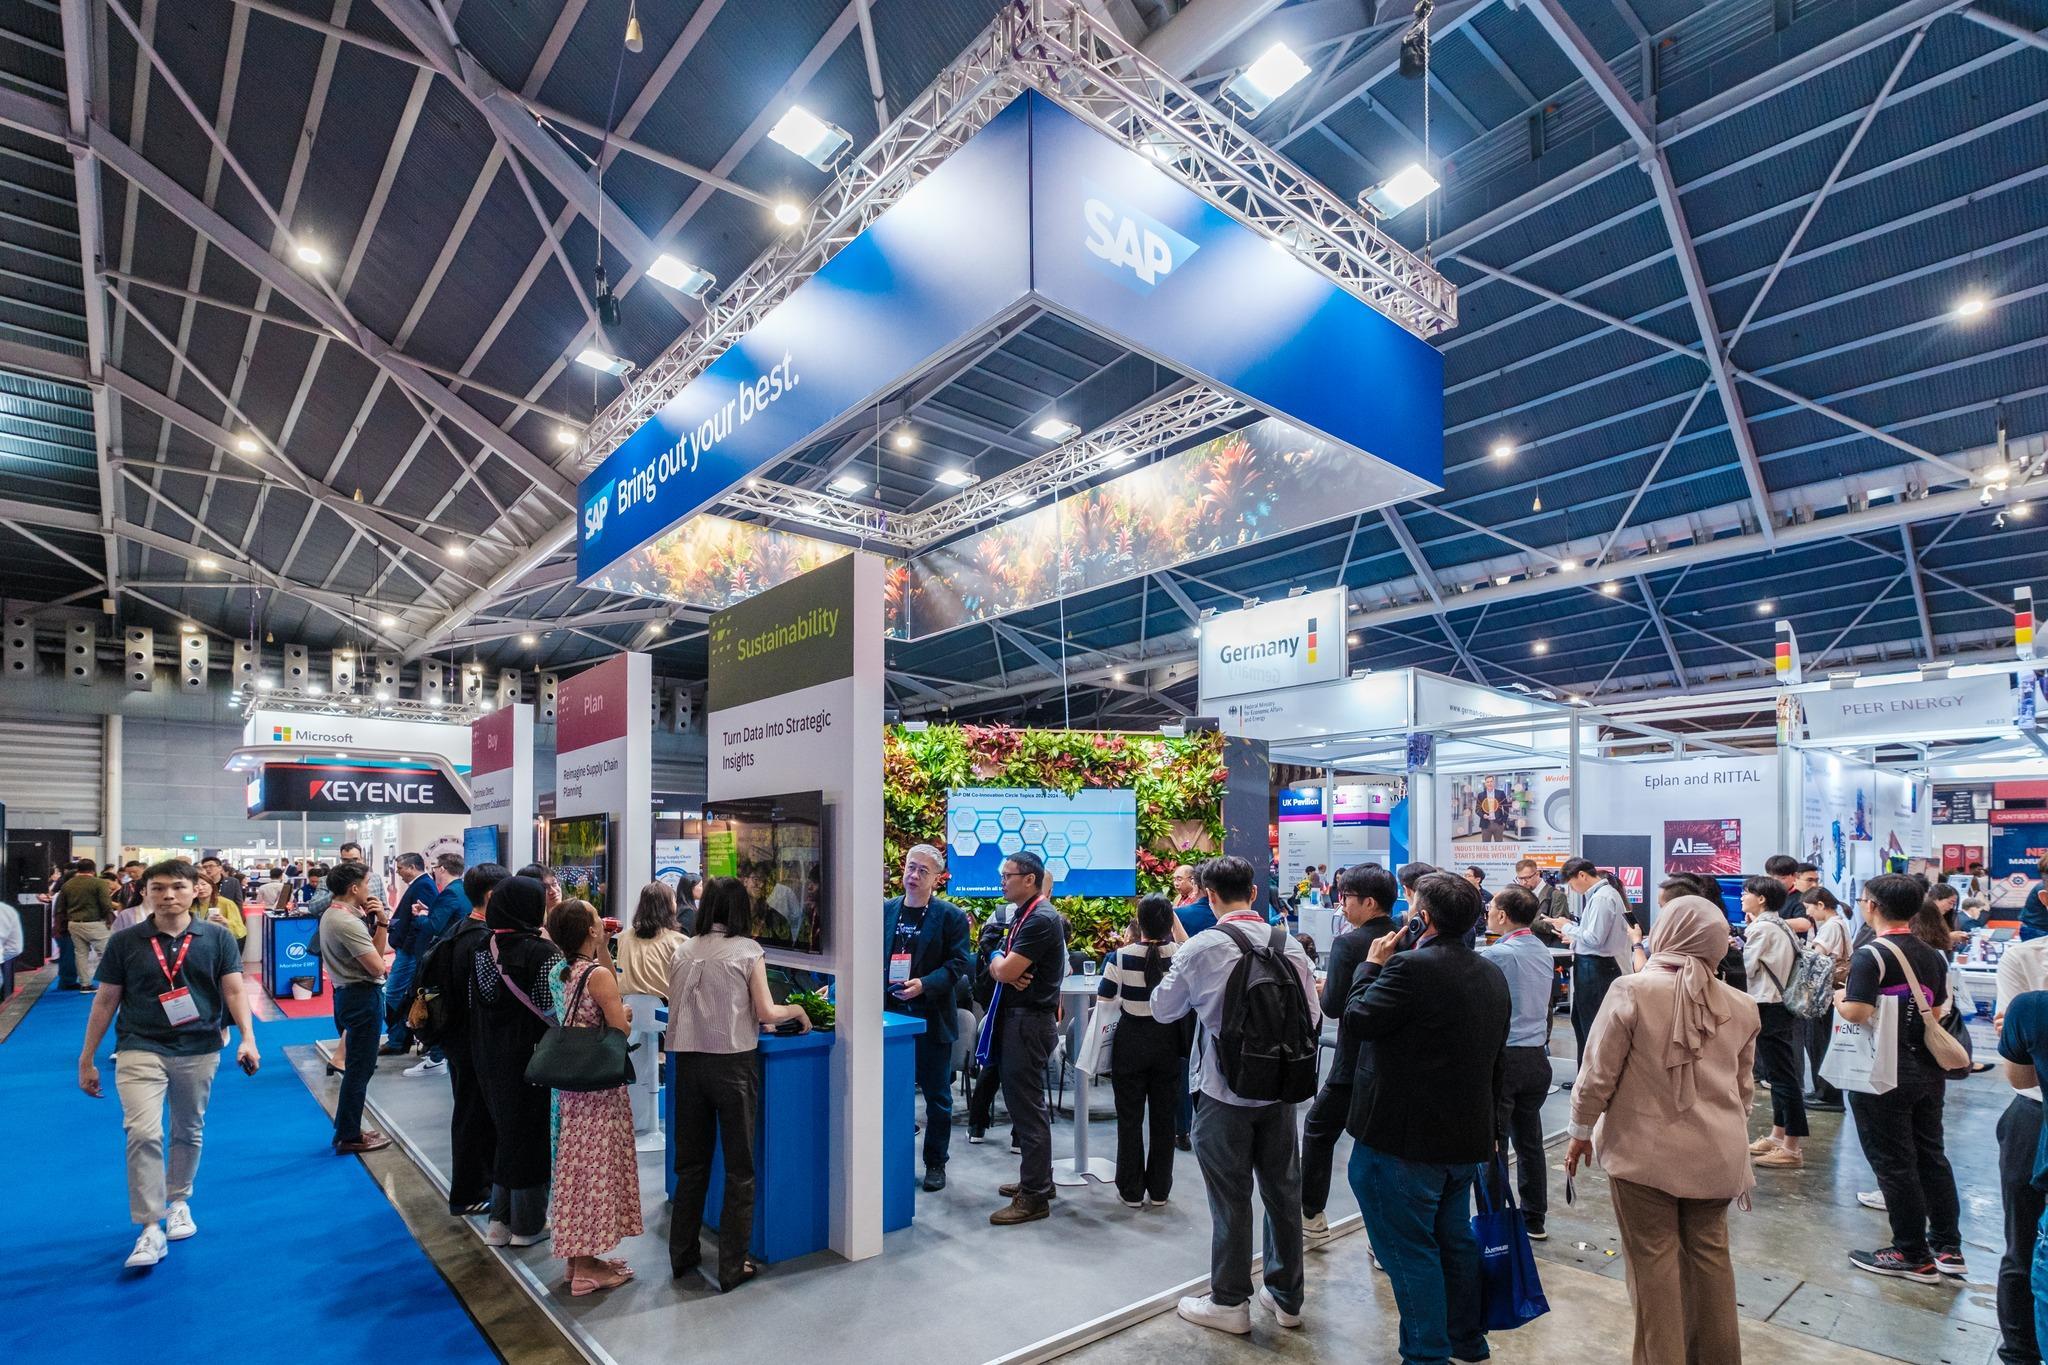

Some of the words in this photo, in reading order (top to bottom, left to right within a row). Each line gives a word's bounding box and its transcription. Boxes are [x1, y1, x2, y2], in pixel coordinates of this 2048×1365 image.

[1084, 198, 1172, 286] SAP
[618, 457, 657, 515] Bring
[658, 431, 688, 483] out
[690, 398, 736, 473] your
[739, 347, 800, 425] best.
[585, 496, 608, 540] SAP
[737, 607, 839, 661] Sustainability
[1220, 636, 1300, 664] Germany
[584, 693, 604, 716] Plan
[1244, 702, 1259, 710] Federal
[1250, 708, 1270, 716] Economic
[1842, 702, 1885, 716] PEER
[1891, 695, 1965, 712] ENERGY
[296, 730, 353, 743] Microsoft
[723, 731, 742, 747] Turn
[743, 725, 764, 742] Data
[765, 722, 784, 738] Into
[785, 709, 832, 734] Strategic
[487, 734, 499, 751] Buy
[563, 766, 587, 781] Reimagine
[586, 762, 603, 777] Supply
[603, 758, 619, 772] Chain
[722, 752, 755, 772] Insights
[1645, 775, 1680, 789] Eplan
[1684, 772, 1709, 786] and
[1713, 770, 1761, 784] RITTAL
[309, 780, 434, 804] KEYENCE
[563, 785, 583, 798] Planning
[490, 798, 511, 809] Collaboration
[1282, 798, 1292, 806] UK
[1293, 798, 1319, 806] Pavilion
[1672, 838, 1693, 853] AI
[2026, 847, 2048, 856] NE
